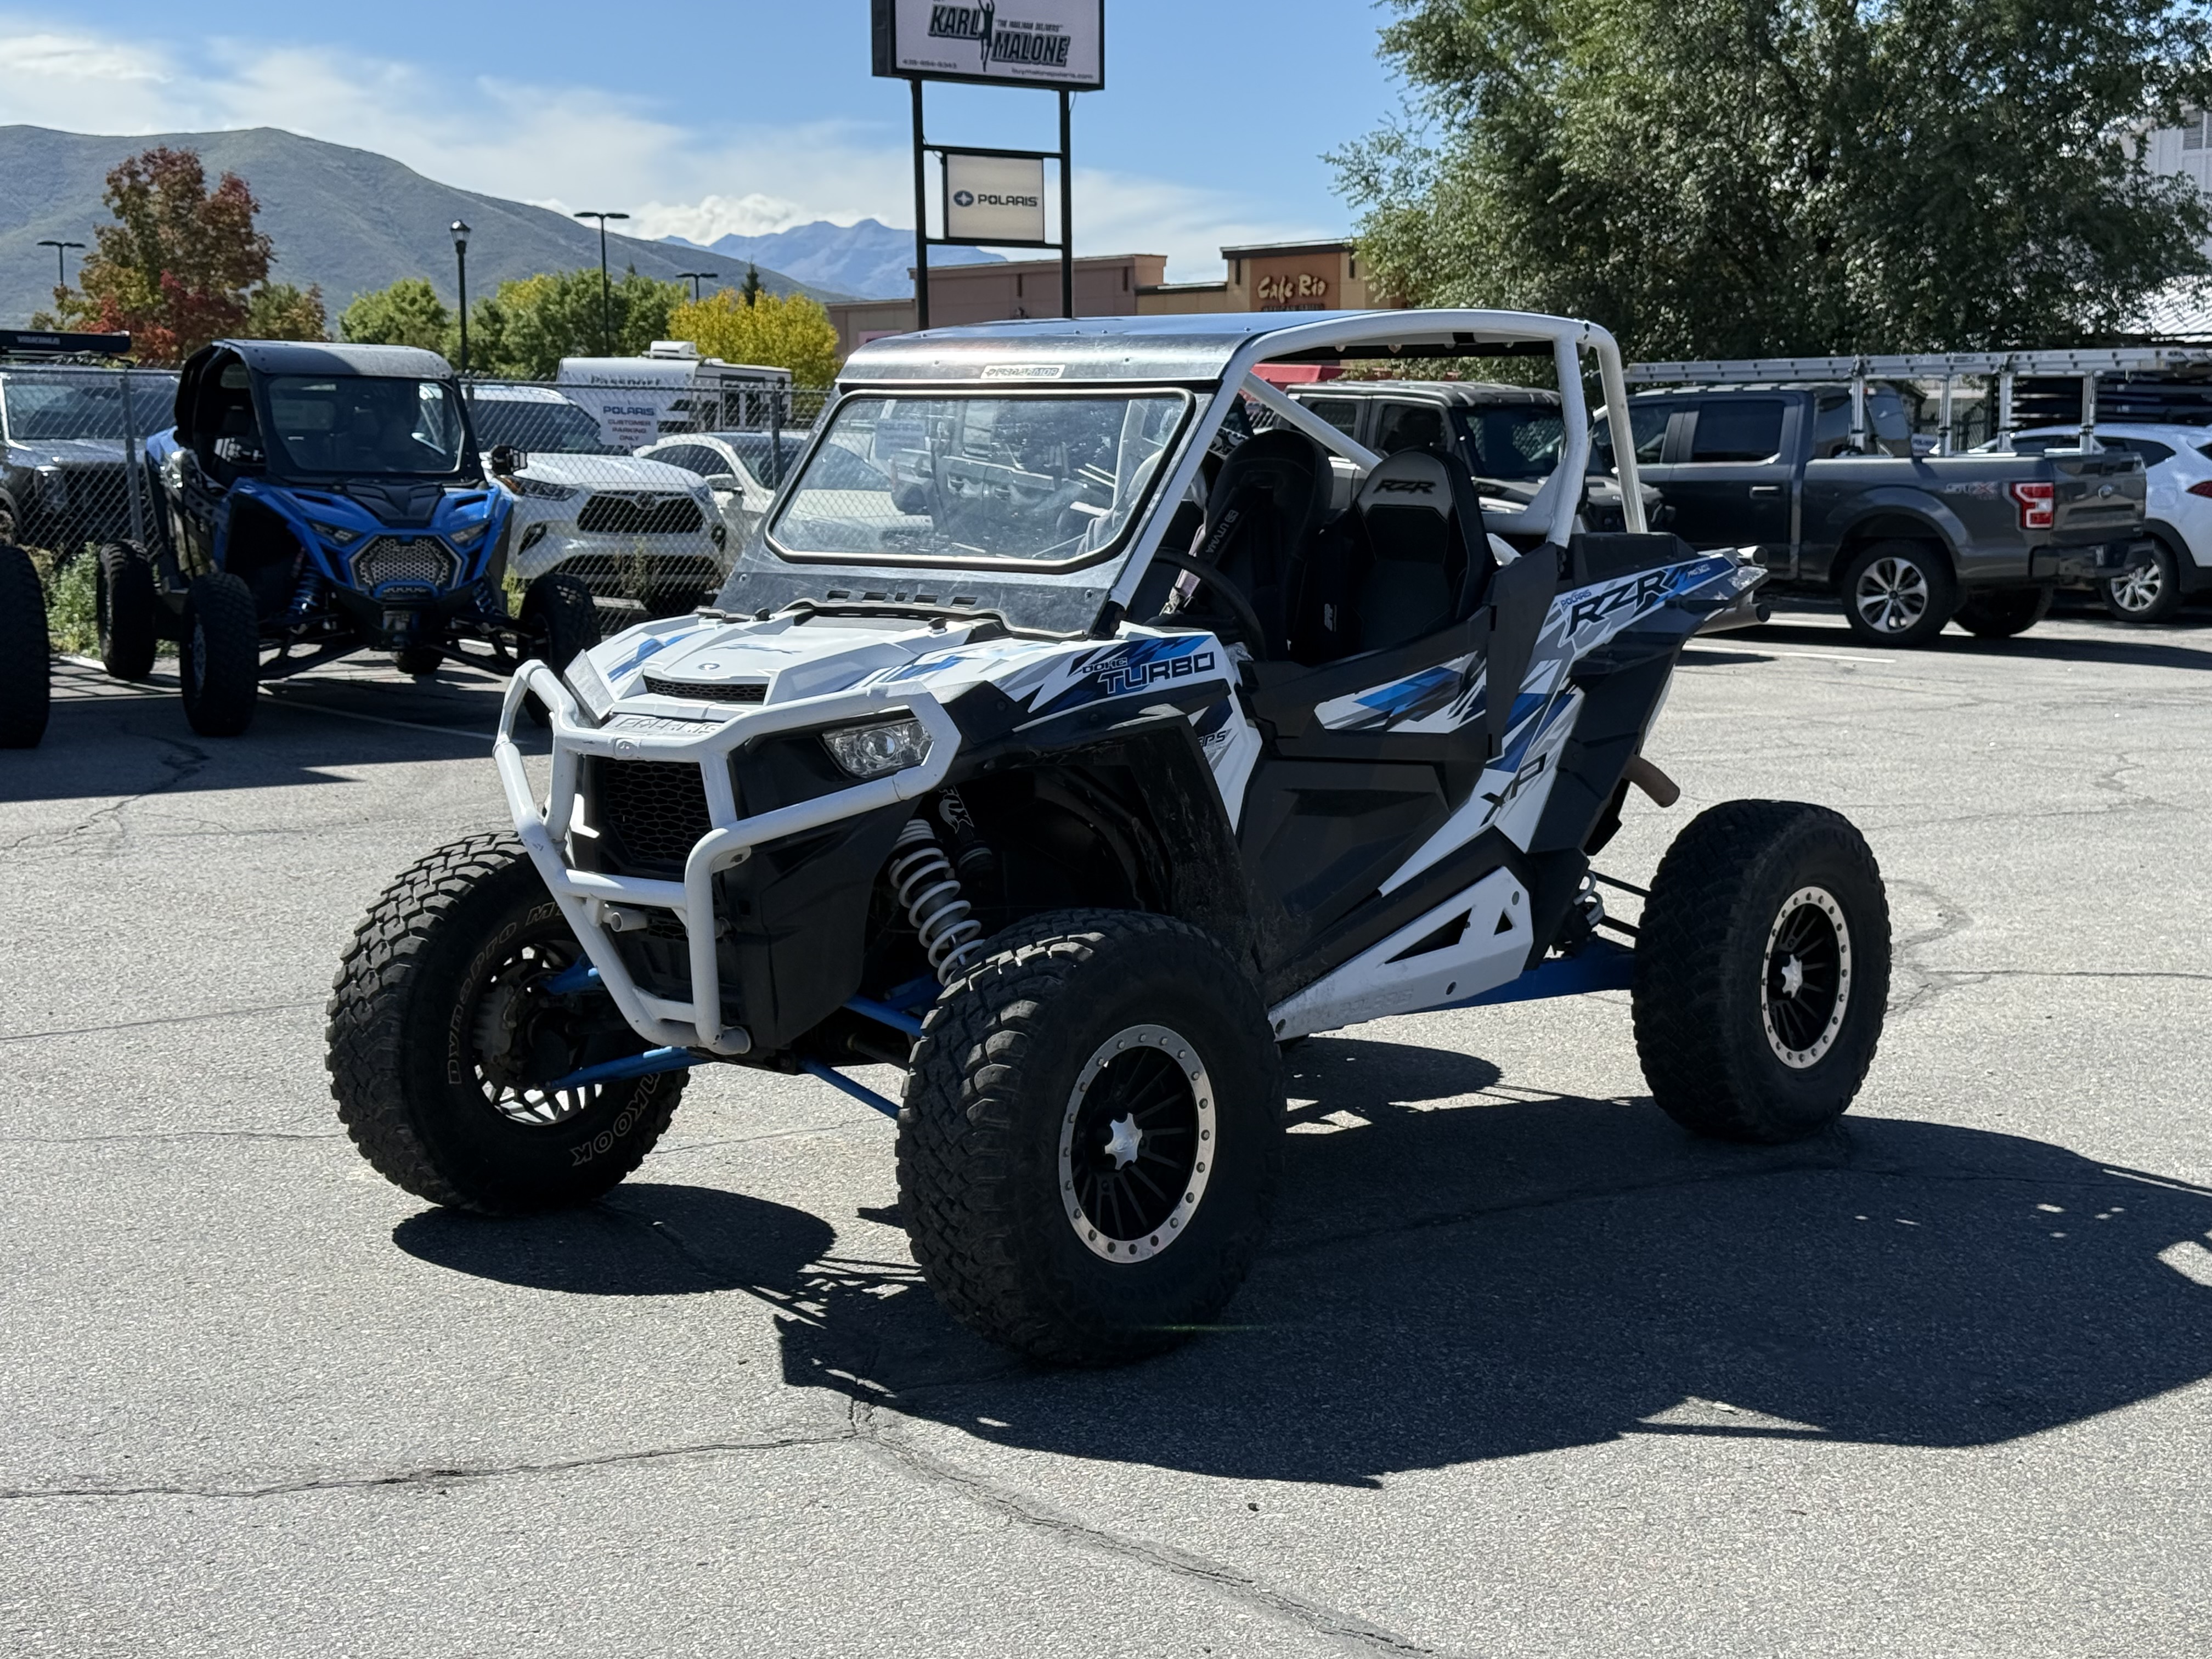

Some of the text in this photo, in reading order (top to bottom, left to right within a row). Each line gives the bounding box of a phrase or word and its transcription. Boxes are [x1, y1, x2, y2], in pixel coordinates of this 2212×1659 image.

[928, 4, 981, 40] KARL
[991, 30, 1070, 67] MALONE
[978, 194, 1038, 207] POLARIS
[1257, 273, 1327, 304] Cafe Rio
[603, 405, 654, 416] POLARIS
[607, 419, 651, 427] CUSTOMER
[1373, 479, 1437, 494] RZR
[1561, 589, 1592, 607] POLARIS
[1565, 570, 1671, 640] RZR
[1082, 657, 1127, 674] DOHC
[1098, 651, 1215, 694] TURBO
[1479, 752, 1548, 827] XP
